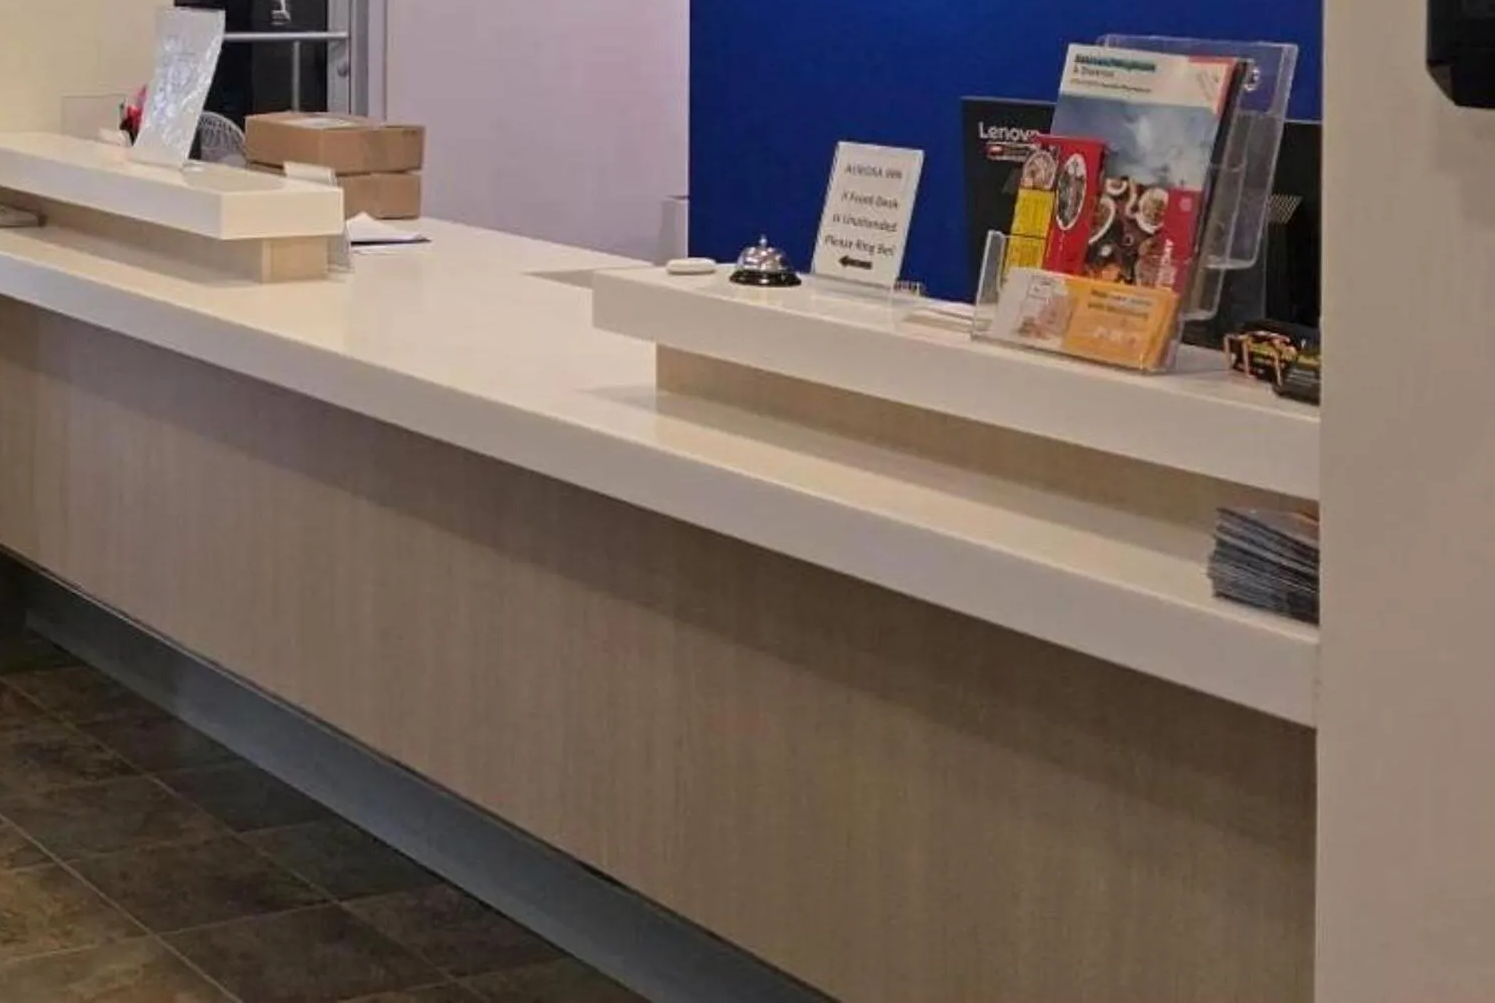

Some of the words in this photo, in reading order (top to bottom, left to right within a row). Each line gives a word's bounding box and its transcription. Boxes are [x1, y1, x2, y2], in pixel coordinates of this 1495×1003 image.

[875, 195, 898, 209] Desk
[842, 214, 898, 233] Unattended
[825, 234, 854, 250] Please
[855, 239, 876, 256] Ring
